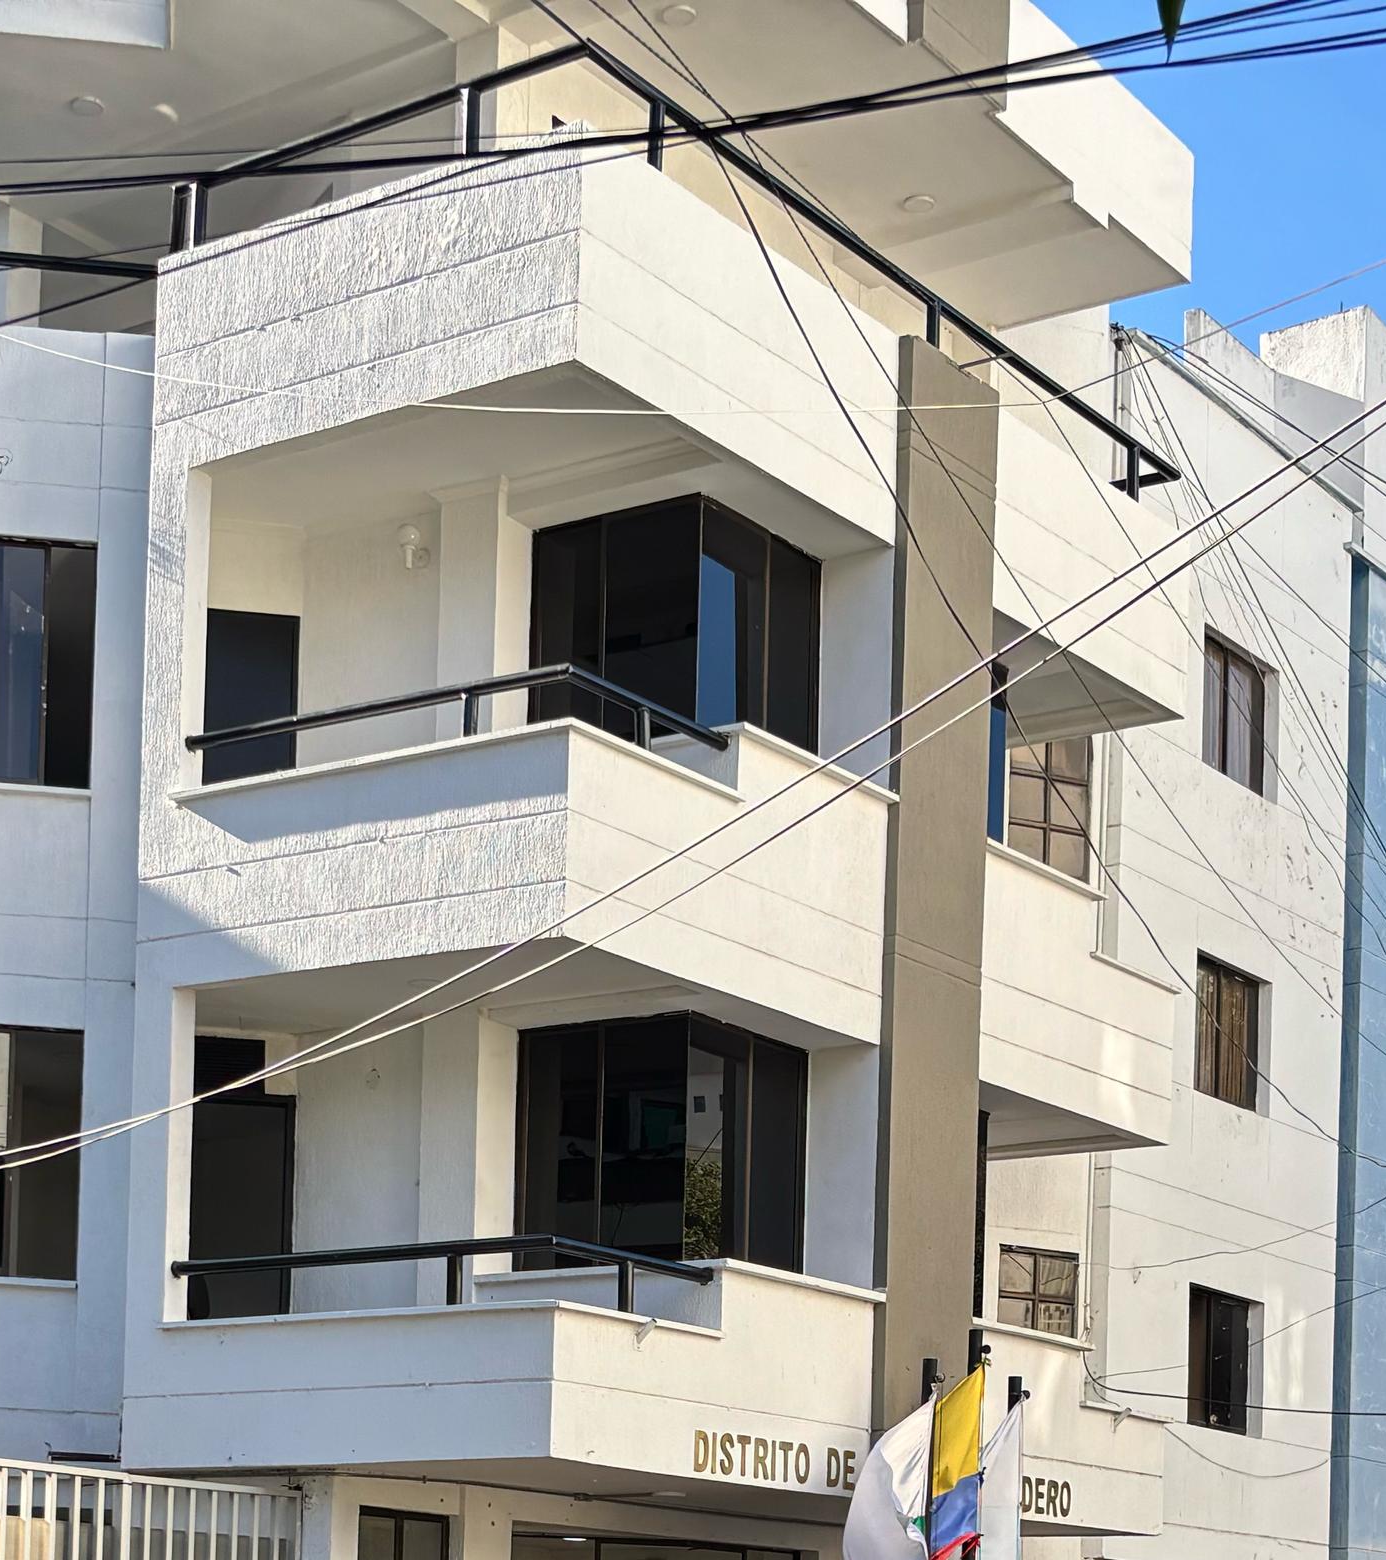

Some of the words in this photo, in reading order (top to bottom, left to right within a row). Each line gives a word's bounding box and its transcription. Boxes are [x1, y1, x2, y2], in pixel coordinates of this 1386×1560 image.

[693, 1429, 810, 1484] DISTRITO
[827, 1447, 856, 1491] DE
[1022, 1475, 1072, 1518] DERO
